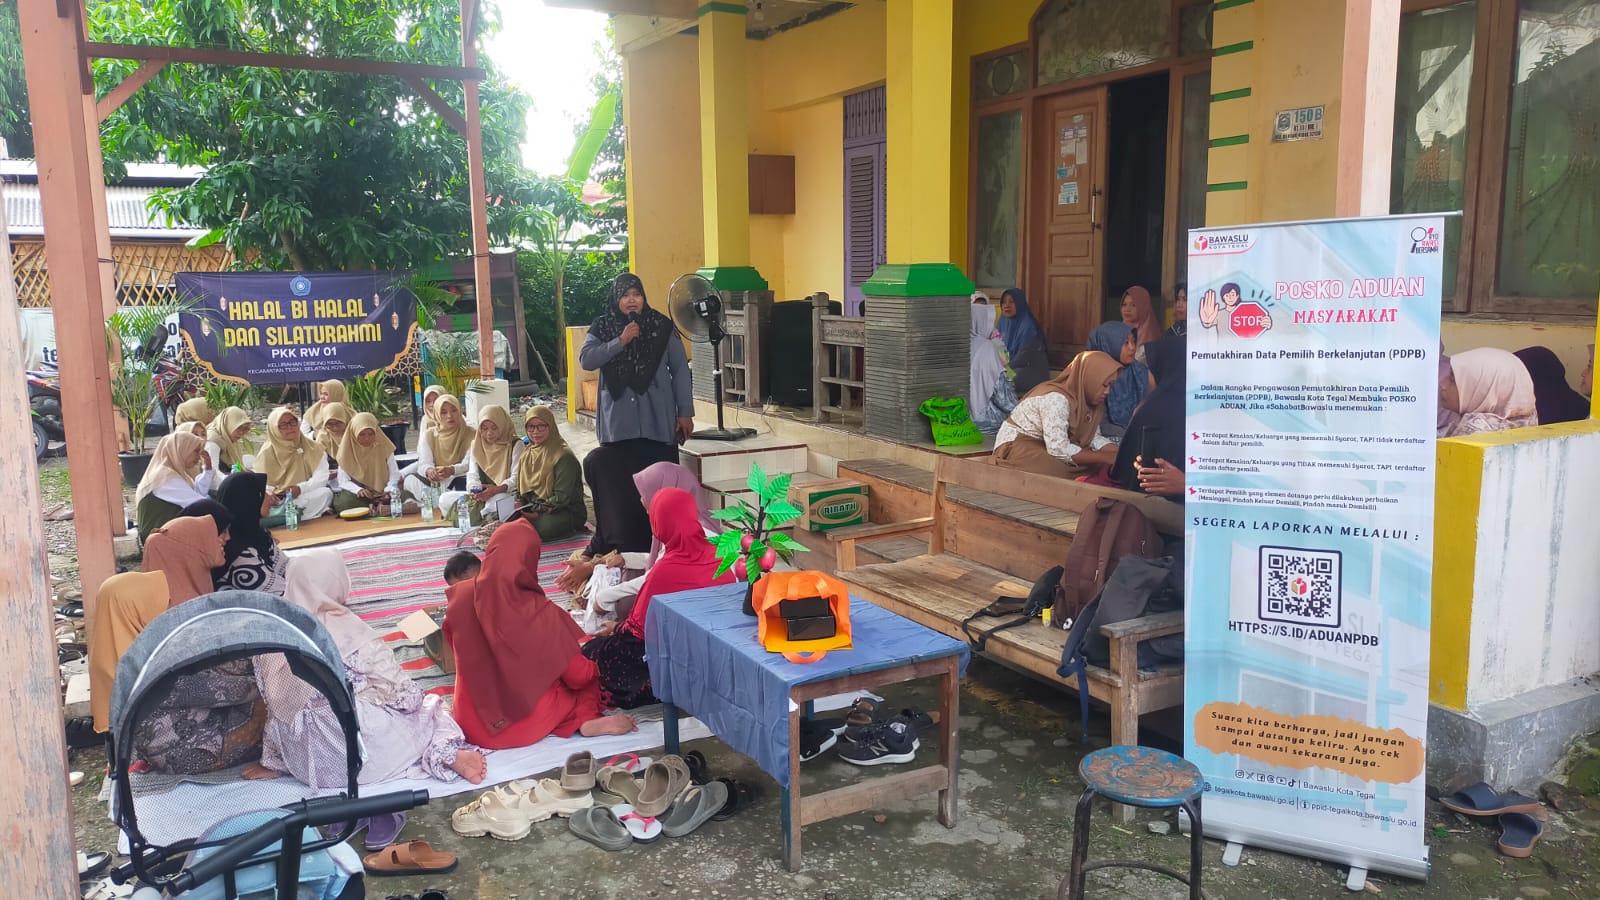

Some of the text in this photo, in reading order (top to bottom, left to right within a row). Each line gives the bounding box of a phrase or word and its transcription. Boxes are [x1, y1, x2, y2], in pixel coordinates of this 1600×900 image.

[1209, 234, 1248, 243] BAWASLU
[1275, 277, 1424, 300] POSKO ADUAN
[229, 299, 368, 320] HALAL BI HALAL
[1292, 308, 1398, 324] MASYARAKAT
[224, 324, 382, 347] DAN SILATURAHMI
[272, 347, 336, 358] PKK RW 01
[1192, 349, 1426, 360] Pemutakhiran Data Pemilih Berkelanjutan (PDPB)
[1194, 517, 1246, 529] SEGERA
[1253, 521, 1333, 534] LAPORKAN
[1340, 526, 1408, 540] MELALUI
[1228, 620, 1378, 646] HTTPS://S.ID/ADUANPDB
[1212, 712, 1404, 746] Suara kita berharga, jadi jangan
[1216, 725, 1400, 758] sampai datanya keliru. Ayo cek
[1232, 738, 1380, 768] dan awasi sekarang juga.
[1304, 782, 1376, 800] Bawaslu Kota Tegal
